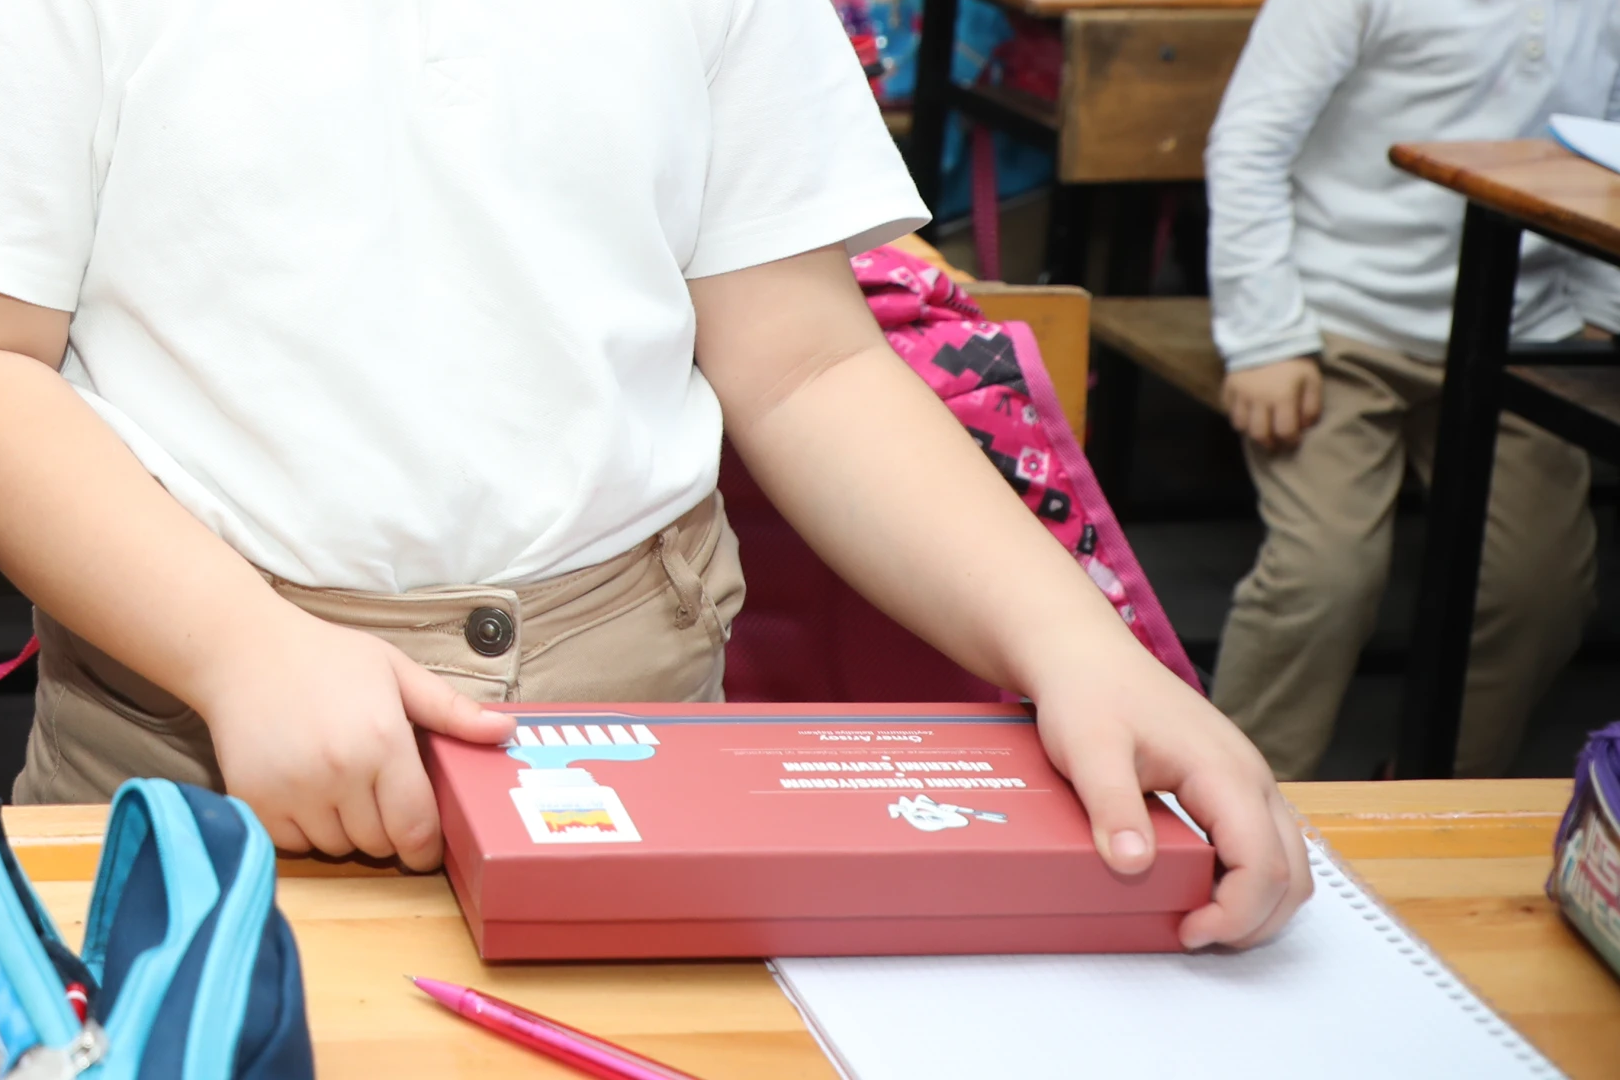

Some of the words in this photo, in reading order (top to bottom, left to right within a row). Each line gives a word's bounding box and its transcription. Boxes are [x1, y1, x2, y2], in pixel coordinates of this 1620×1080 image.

[819, 734, 871, 742] Arısoy
[876, 735, 923, 743] Ömer
[895, 760, 994, 772] DİŞLERİMİ
[923, 777, 1027, 789] SAĞLIĞIMI
